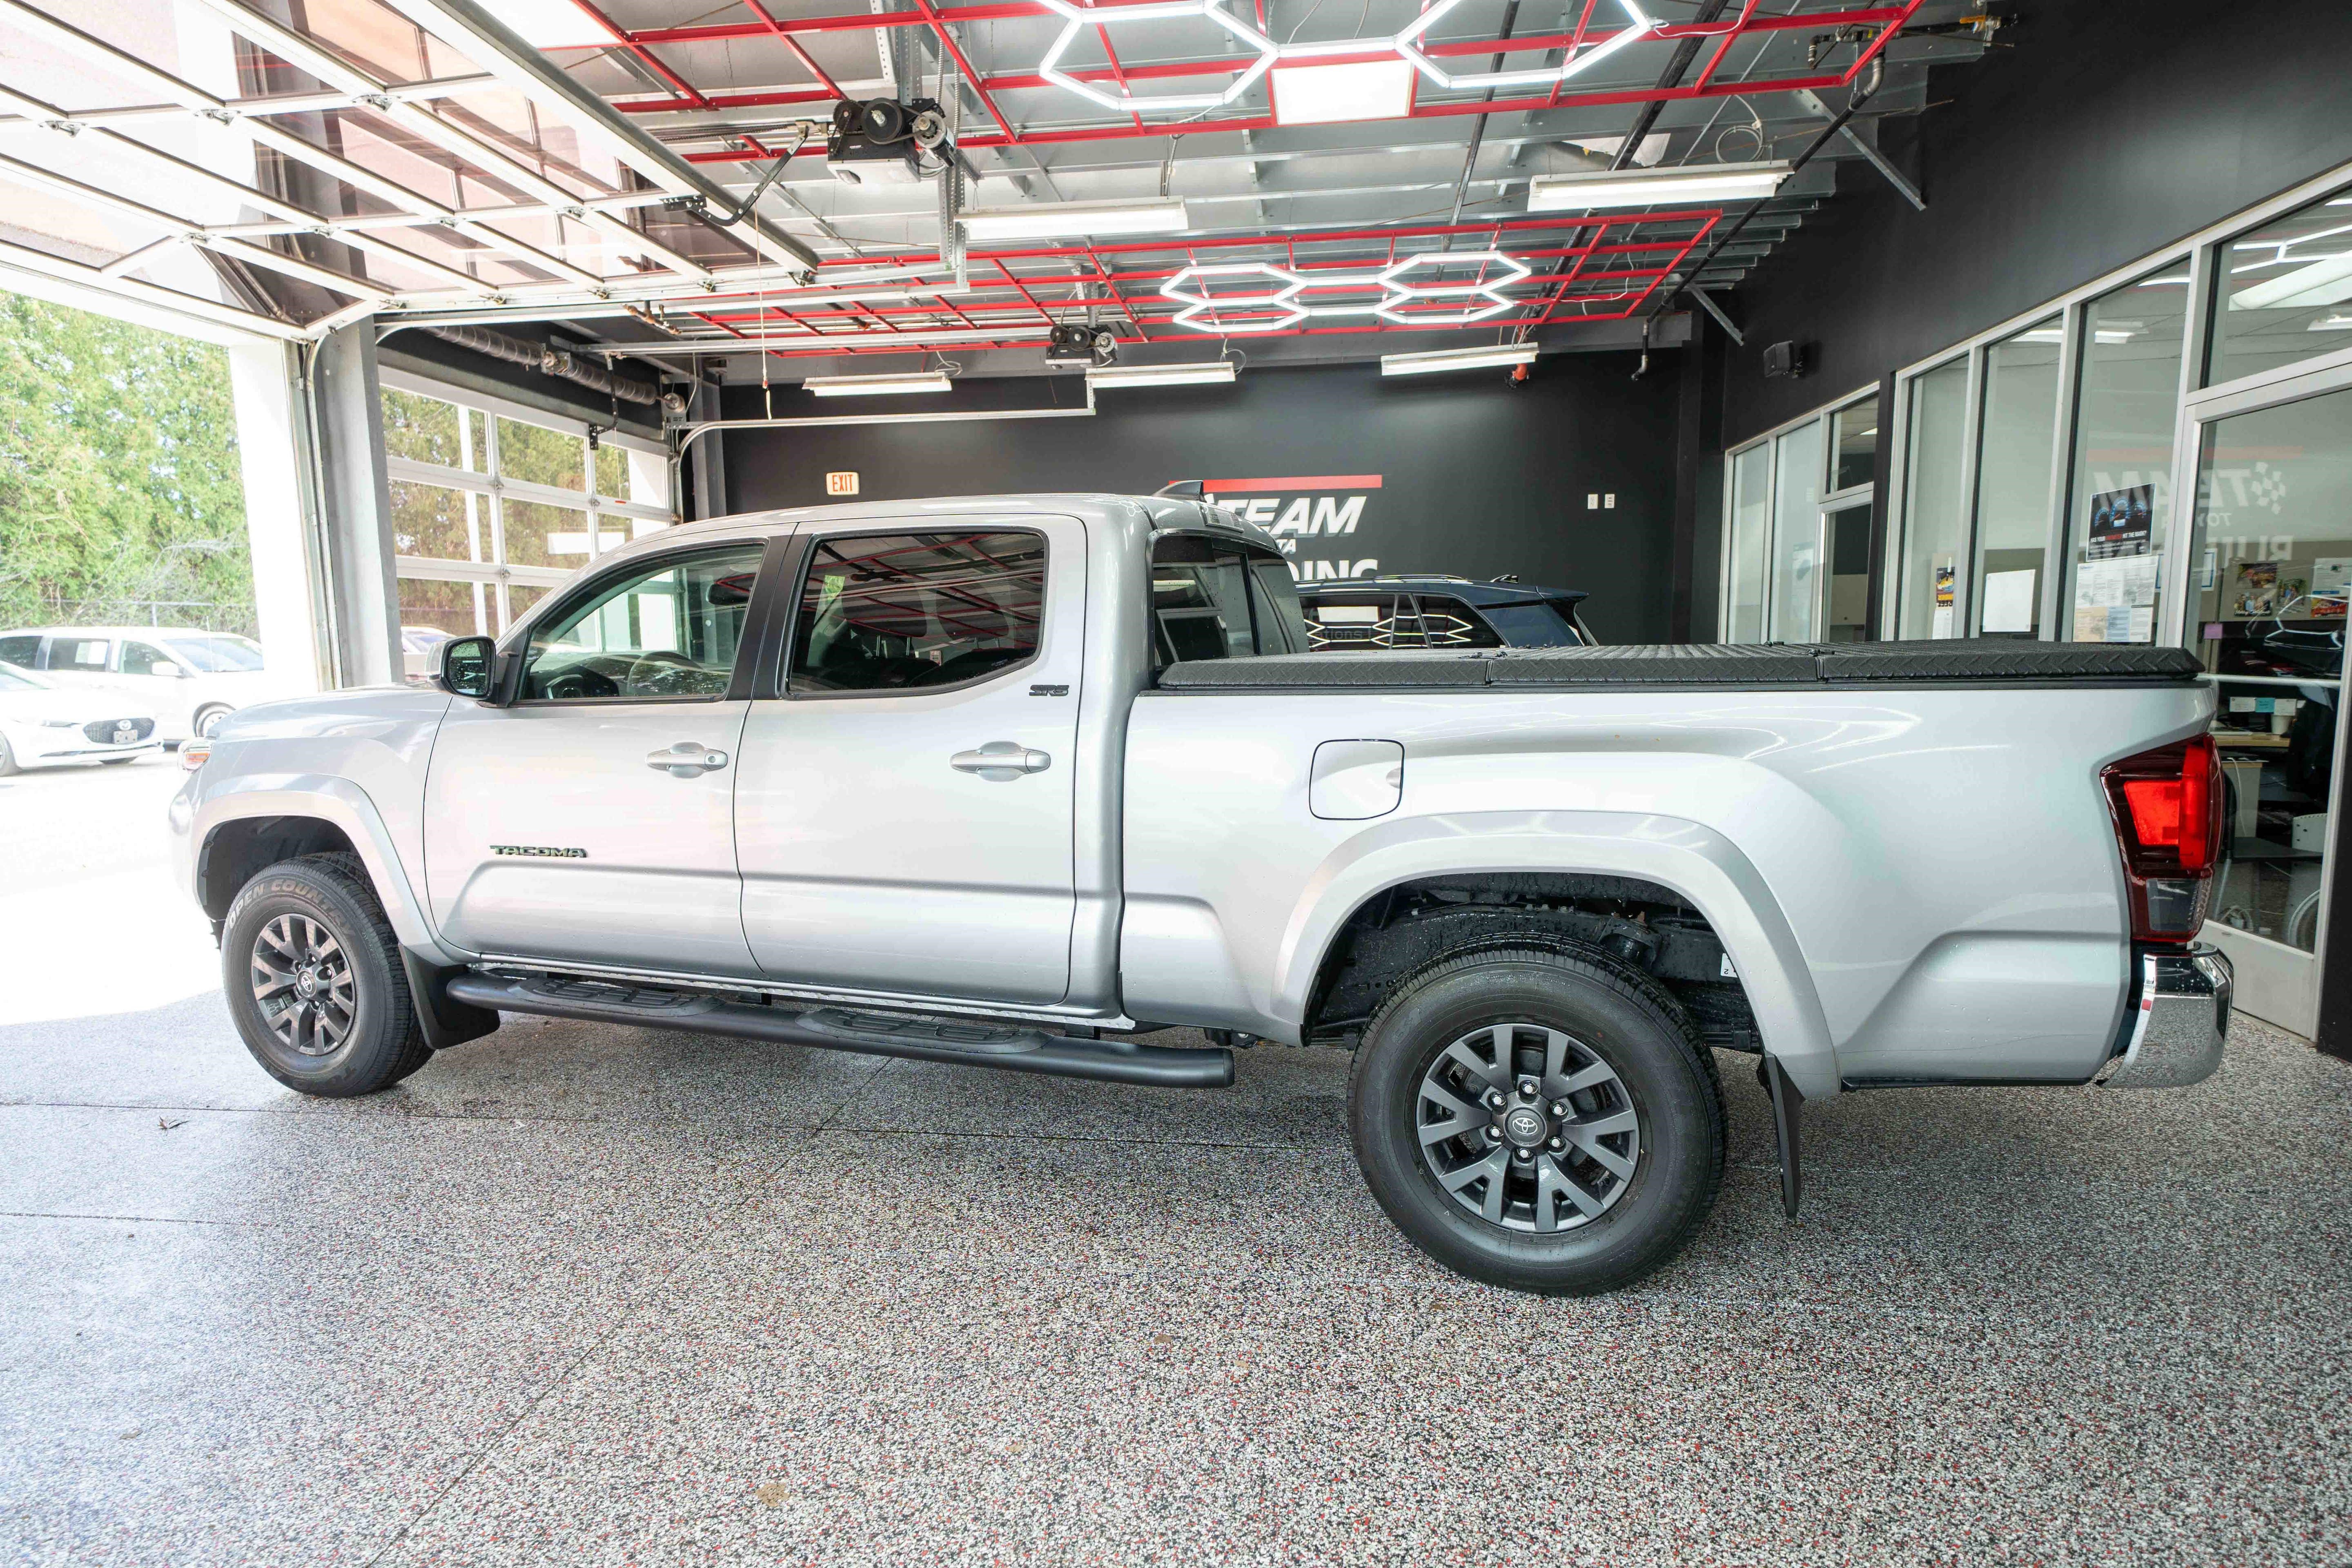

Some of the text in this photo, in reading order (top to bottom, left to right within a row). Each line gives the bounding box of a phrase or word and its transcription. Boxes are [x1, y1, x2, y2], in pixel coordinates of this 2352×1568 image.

[832, 474, 853, 492] EXIT
[1029, 685, 1069, 696] SR5
[489, 845, 587, 858] TACOMA
[229, 878, 356, 936] OPEN COUNTRY
